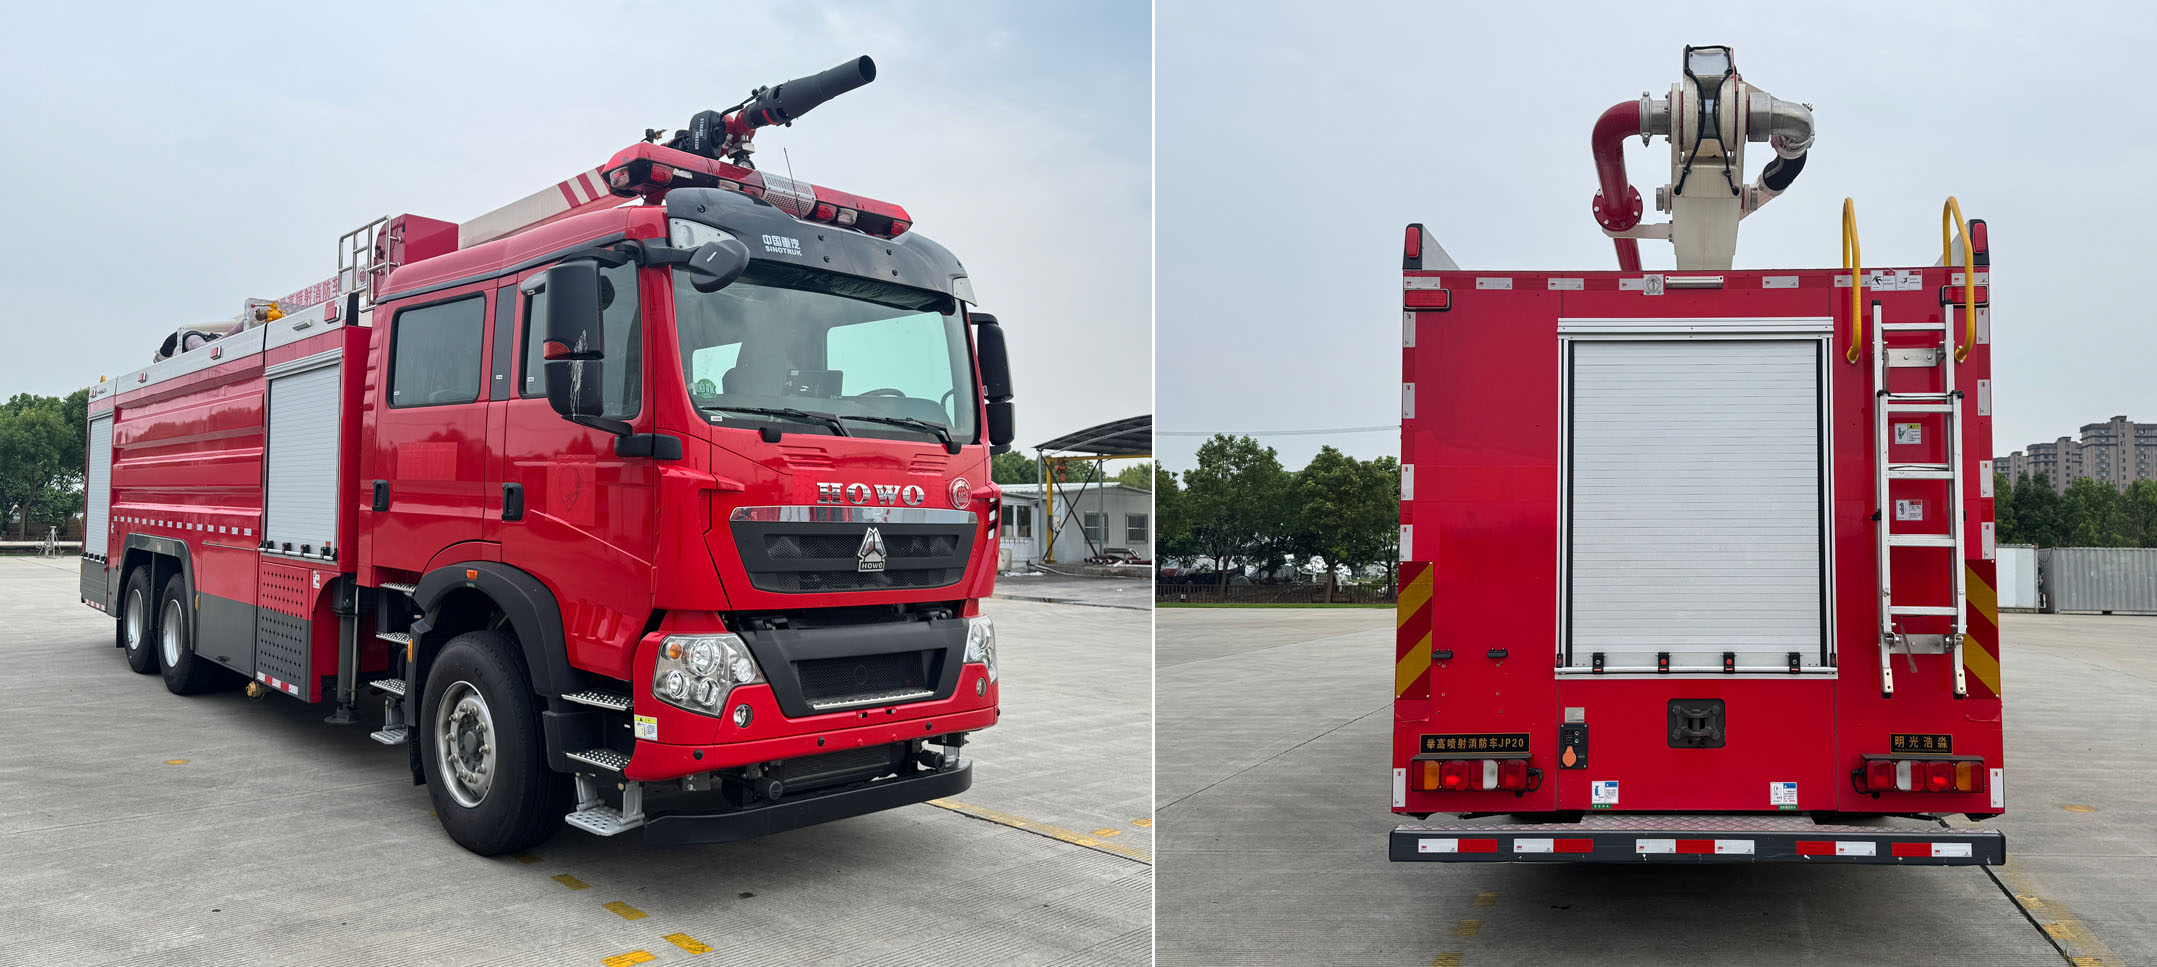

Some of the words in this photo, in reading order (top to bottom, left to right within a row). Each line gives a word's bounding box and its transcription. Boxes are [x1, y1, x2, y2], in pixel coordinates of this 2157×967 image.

[762, 235, 801, 249] 中国重汽
[765, 246, 802, 256] SINOTRUK
[816, 482, 925, 506] HOWO
